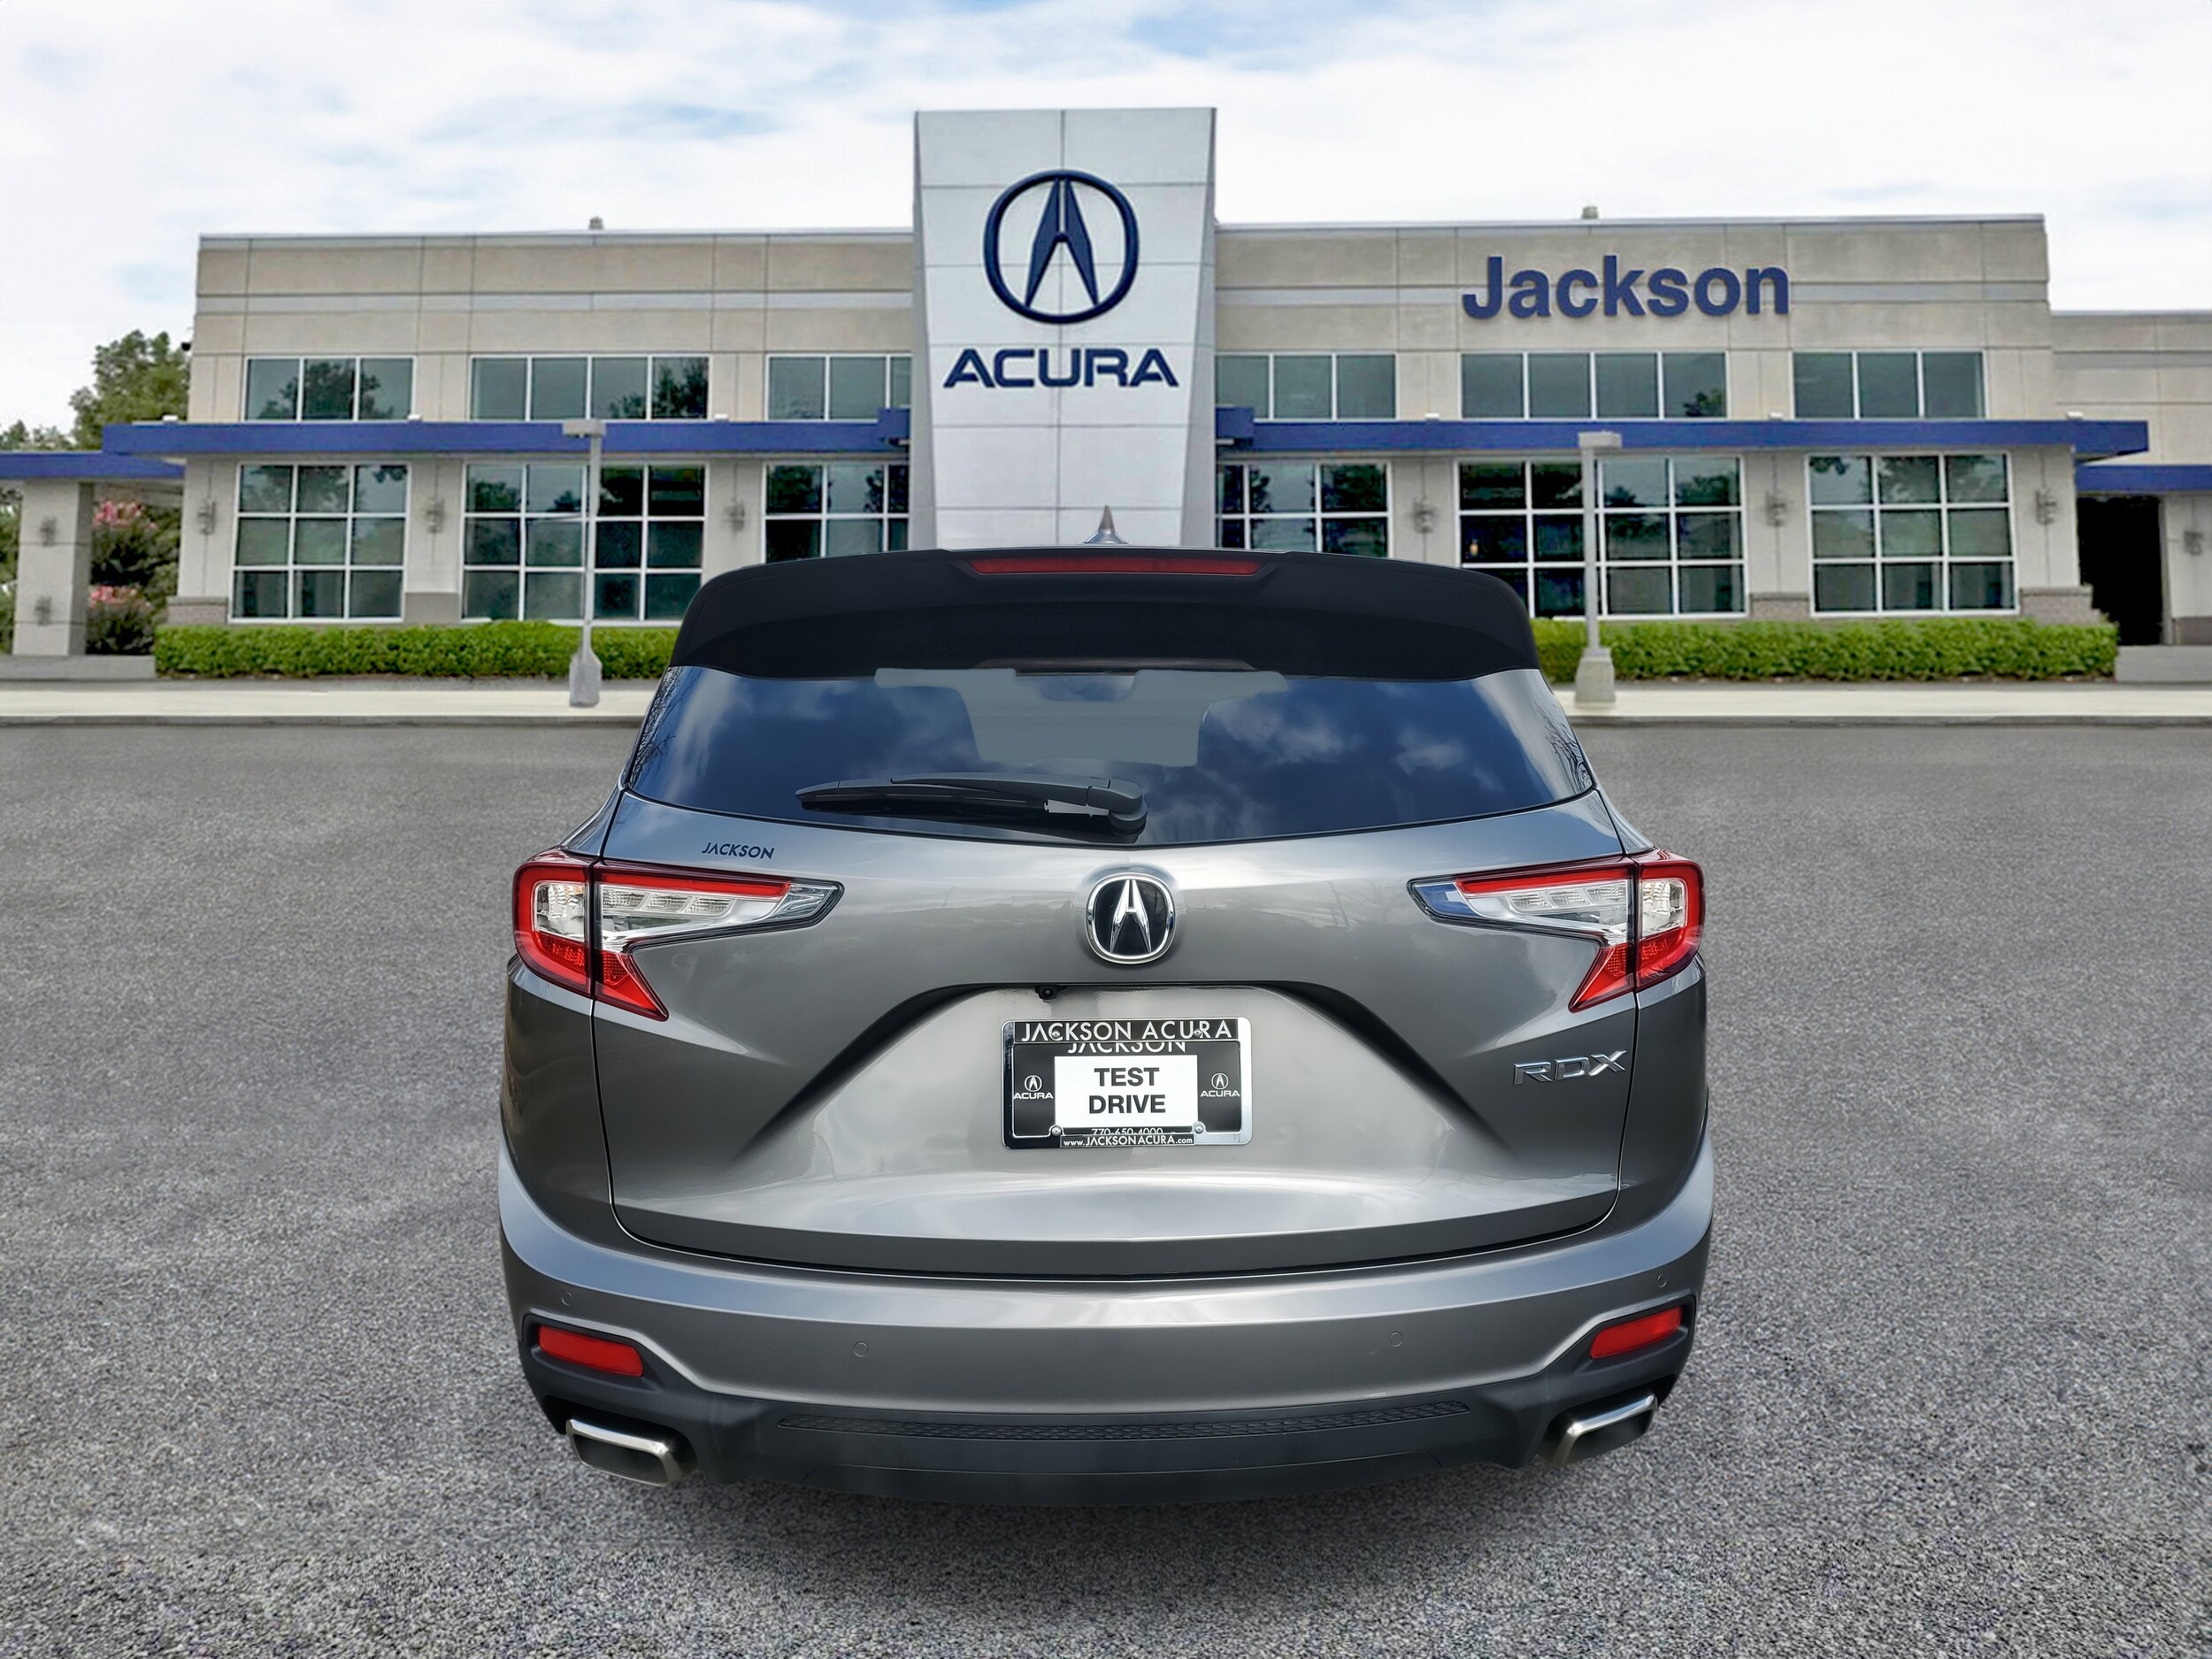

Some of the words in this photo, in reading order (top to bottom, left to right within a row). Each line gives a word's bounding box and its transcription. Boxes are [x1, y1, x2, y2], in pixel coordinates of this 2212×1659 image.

[1463, 255, 1790, 319] Jackson
[943, 348, 1179, 388] ACURA
[702, 841, 775, 860] JACKSON
[1021, 1021, 1132, 1042] JACKSON
[1141, 1019, 1233, 1041] ACURA
[1094, 1067, 1160, 1087] TEST
[1514, 1049, 1628, 1086] RDX
[1088, 1094, 1166, 1114] DRIVE
[1064, 1134, 1193, 1147] www.JACKSONACURA.com
